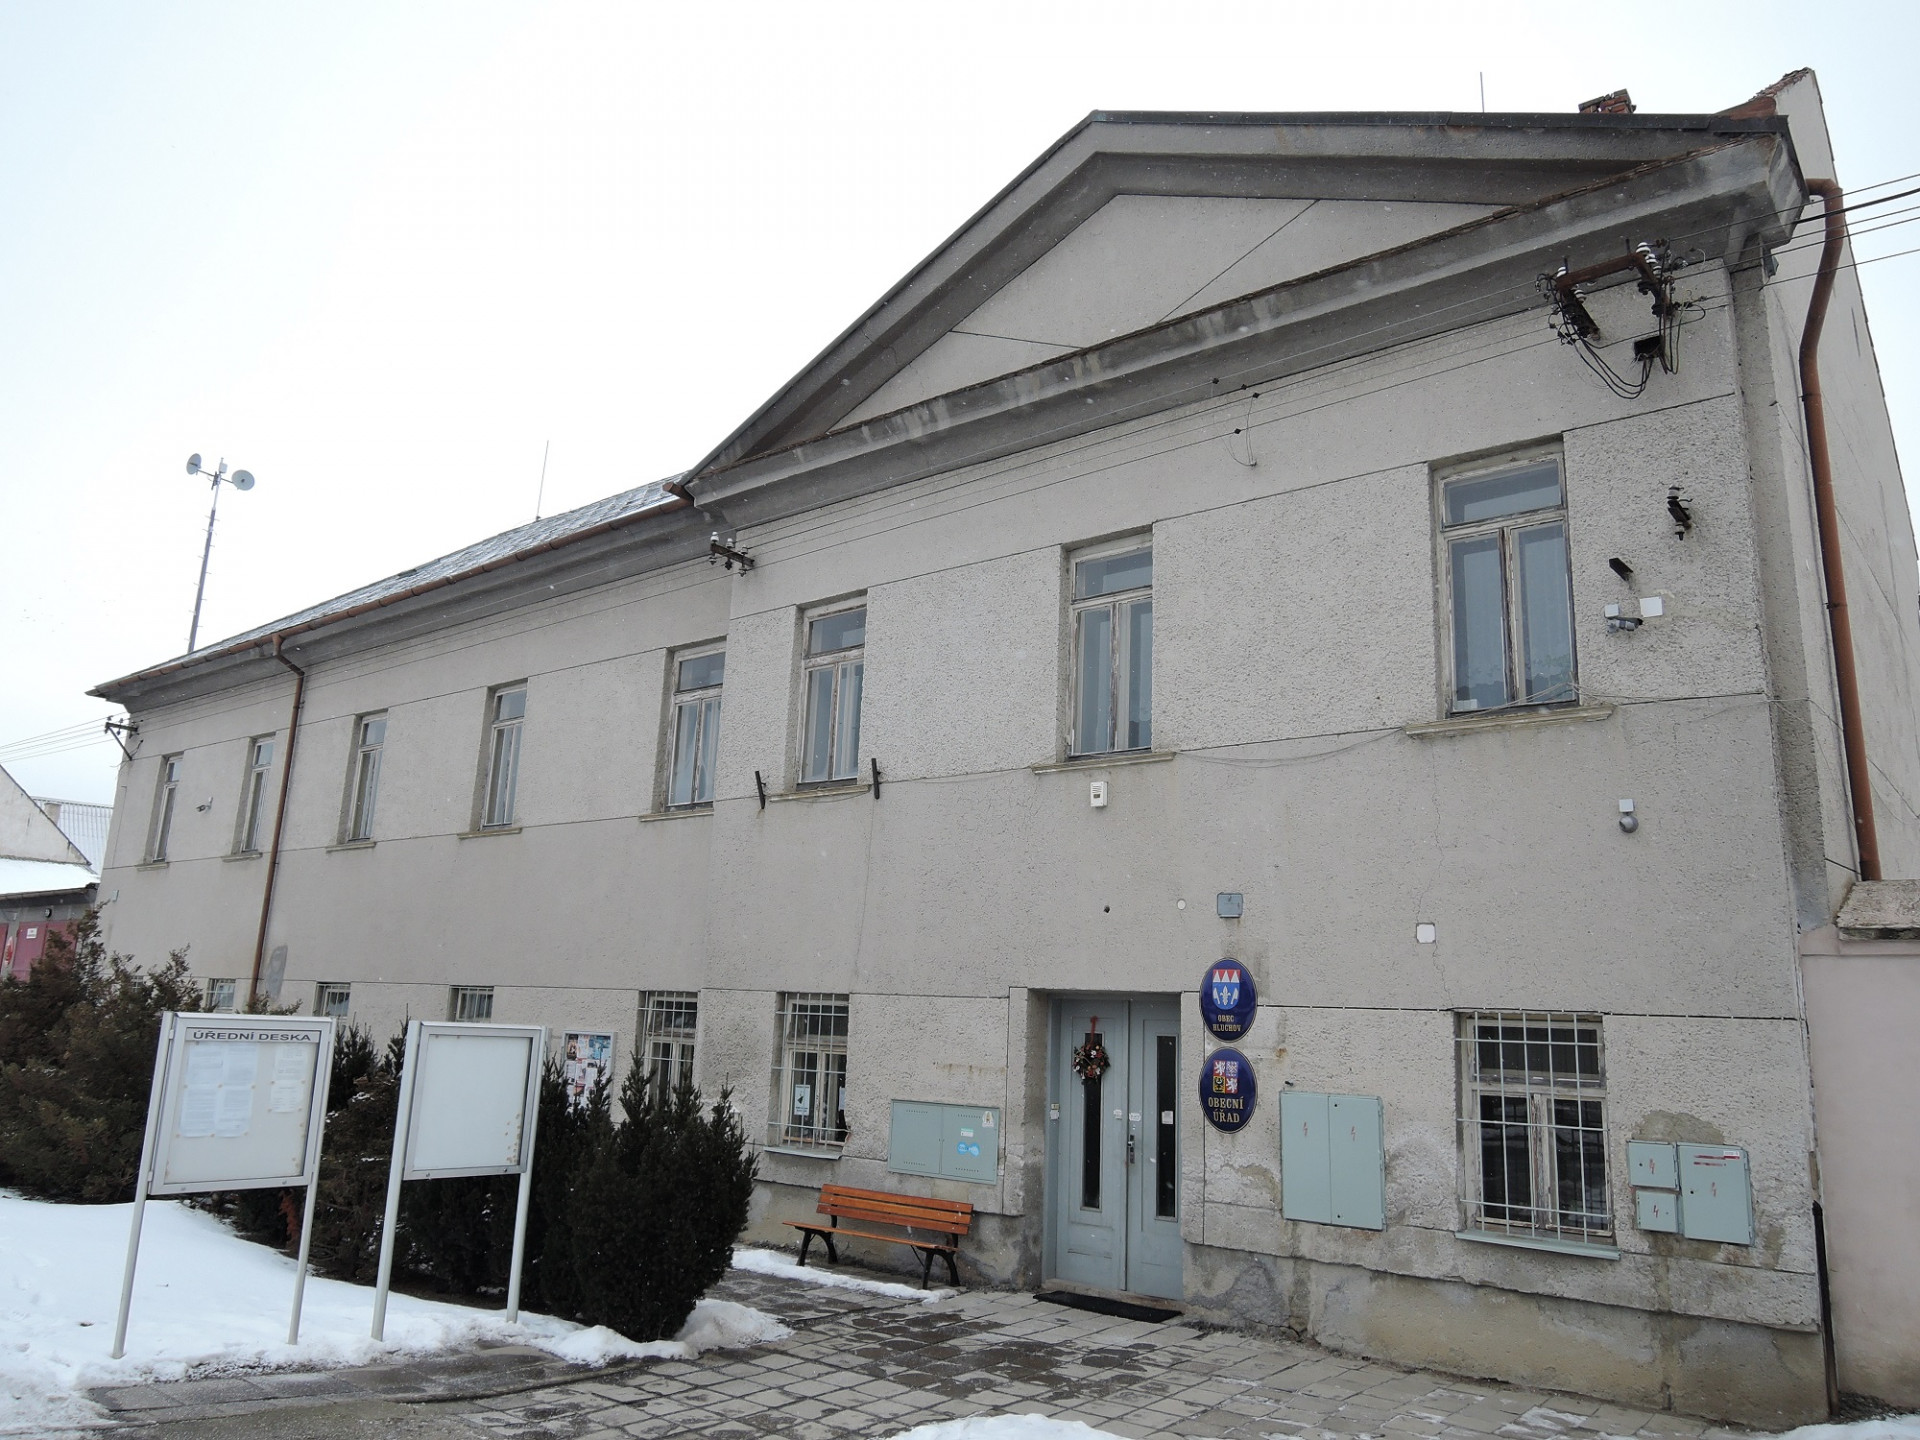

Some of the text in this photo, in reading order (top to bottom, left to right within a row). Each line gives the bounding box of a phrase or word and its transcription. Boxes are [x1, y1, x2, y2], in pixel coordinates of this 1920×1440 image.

[1217, 1014, 1235, 1023] OBEC
[1212, 1024, 1241, 1032] HLUCHOV
[193, 1030, 311, 1041] ÚŘEDNÍ DESKA
[1208, 1096, 1243, 1109] OBECNÍ
[1213, 1108, 1240, 1123] ÚŘAD
